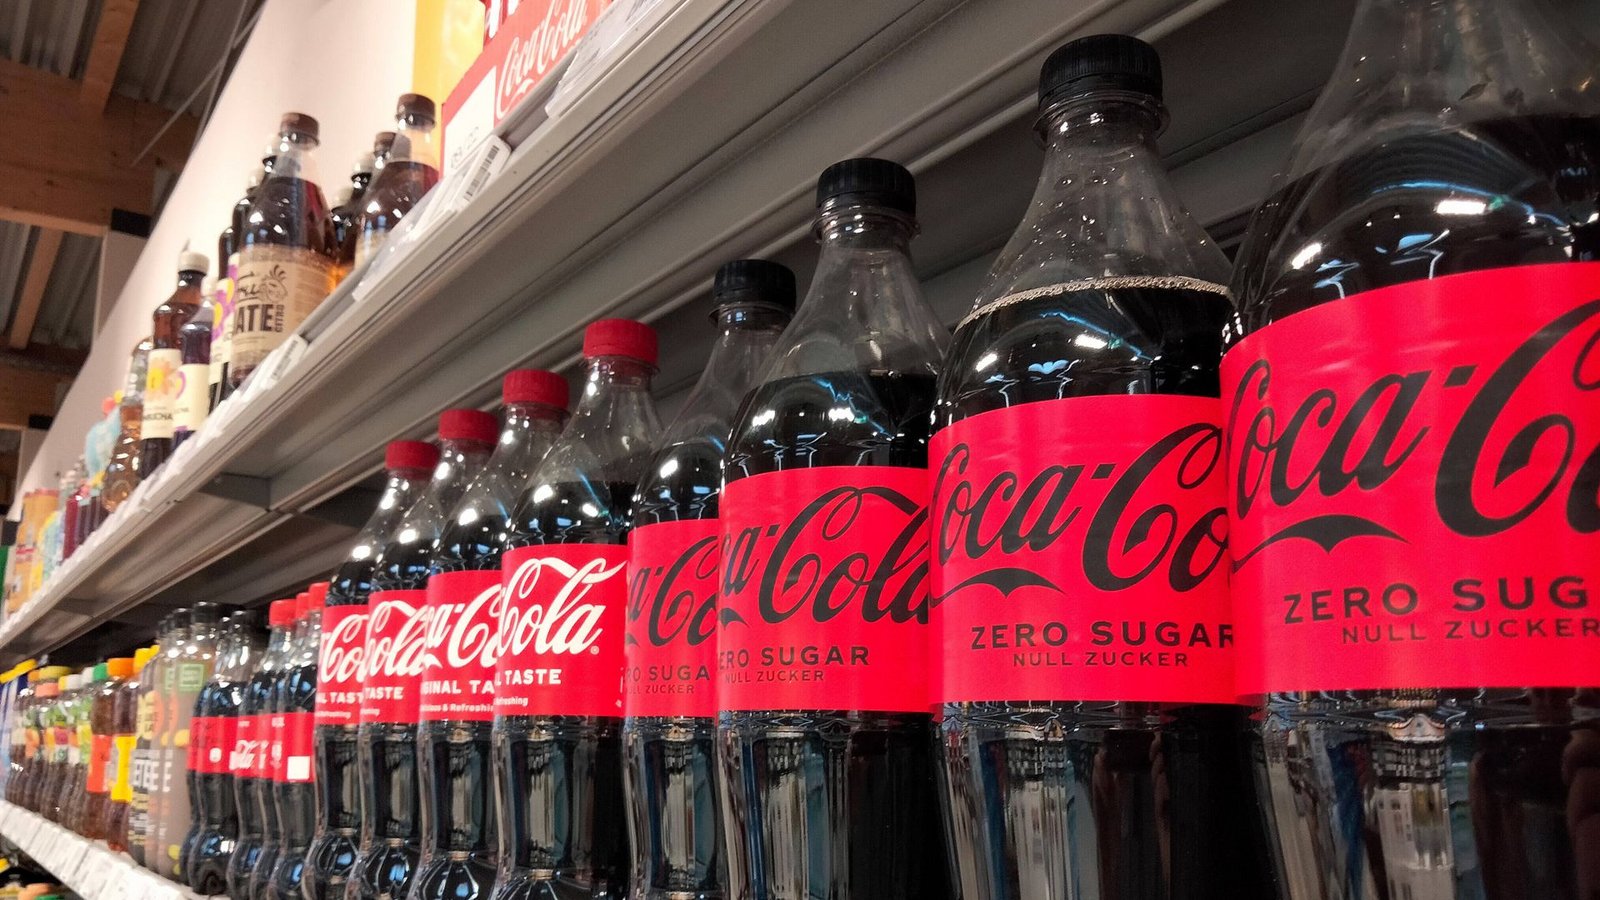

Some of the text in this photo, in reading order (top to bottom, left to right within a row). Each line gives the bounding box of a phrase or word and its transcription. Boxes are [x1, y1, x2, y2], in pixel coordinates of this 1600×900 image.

[1283, 575, 1589, 625] ZERO SUG
[970, 621, 1234, 650] ZERO SUGAR
[1341, 618, 1600, 645] NULL ZUCKER
[760, 645, 870, 667] SUGAR
[1012, 652, 1189, 667] NULL ZUCKER
[504, 668, 562, 685] TASTE
[756, 670, 825, 683] ZUCKER
[645, 684, 695, 695] ZUCKER
